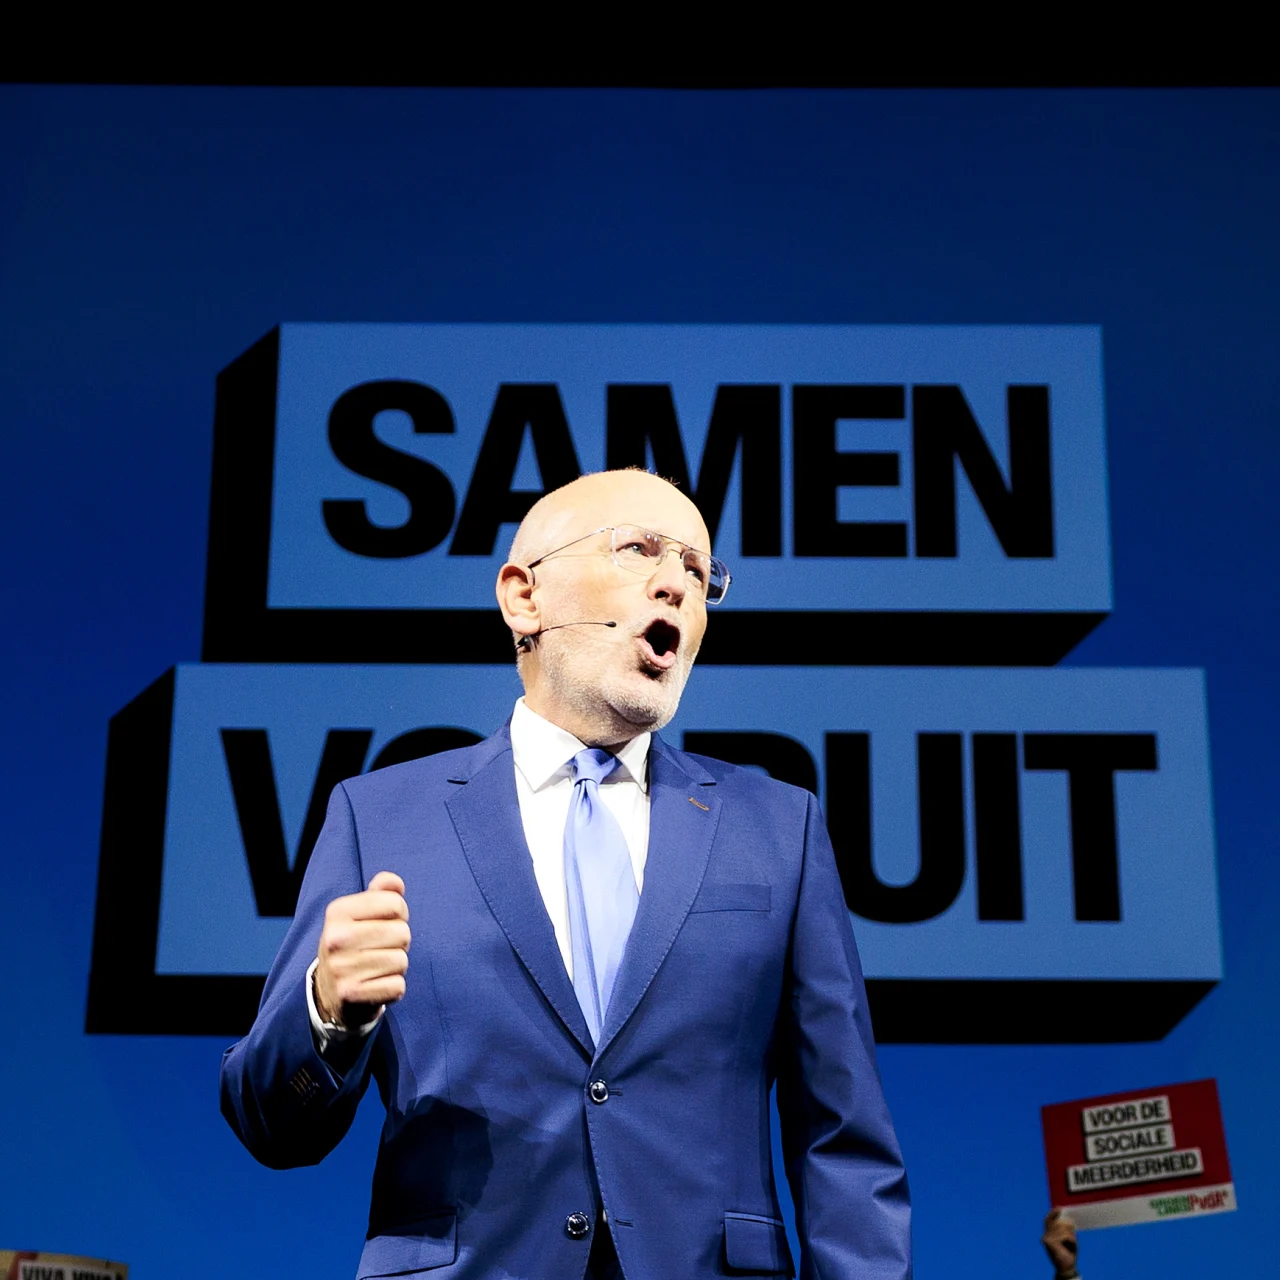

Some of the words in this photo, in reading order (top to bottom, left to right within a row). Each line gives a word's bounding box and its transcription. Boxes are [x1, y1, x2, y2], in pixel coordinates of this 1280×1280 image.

[321, 378, 1057, 559] SAMEN
[218, 725, 1160, 924] VUIT
[1088, 1105, 1137, 1128] VOOR
[1140, 1100, 1165, 1120] DE
[1094, 1128, 1168, 1155] SOCIALE
[1073, 1152, 1198, 1186] MEERDERHEID
